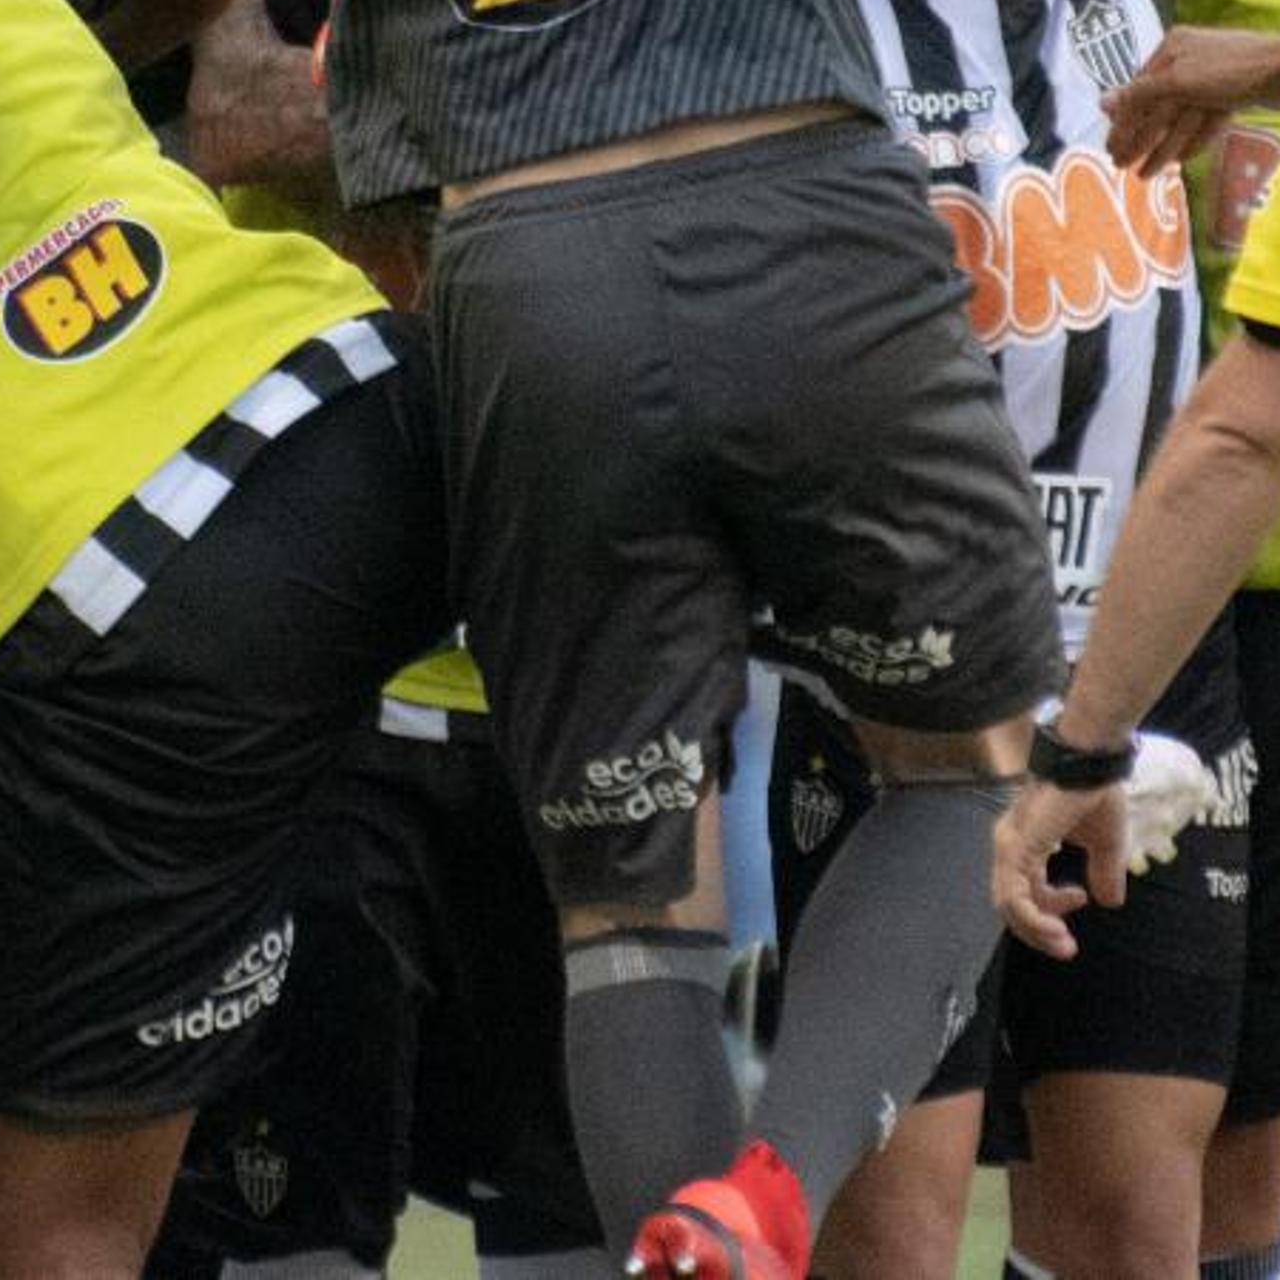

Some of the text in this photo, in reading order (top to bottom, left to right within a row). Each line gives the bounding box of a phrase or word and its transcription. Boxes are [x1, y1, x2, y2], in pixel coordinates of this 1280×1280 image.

[890, 85, 995, 122] Topper
[925, 150, 1190, 350] BMG
[19, 224, 150, 355] BH
[586, 741, 664, 789] eco
[539, 781, 699, 831] cidades
